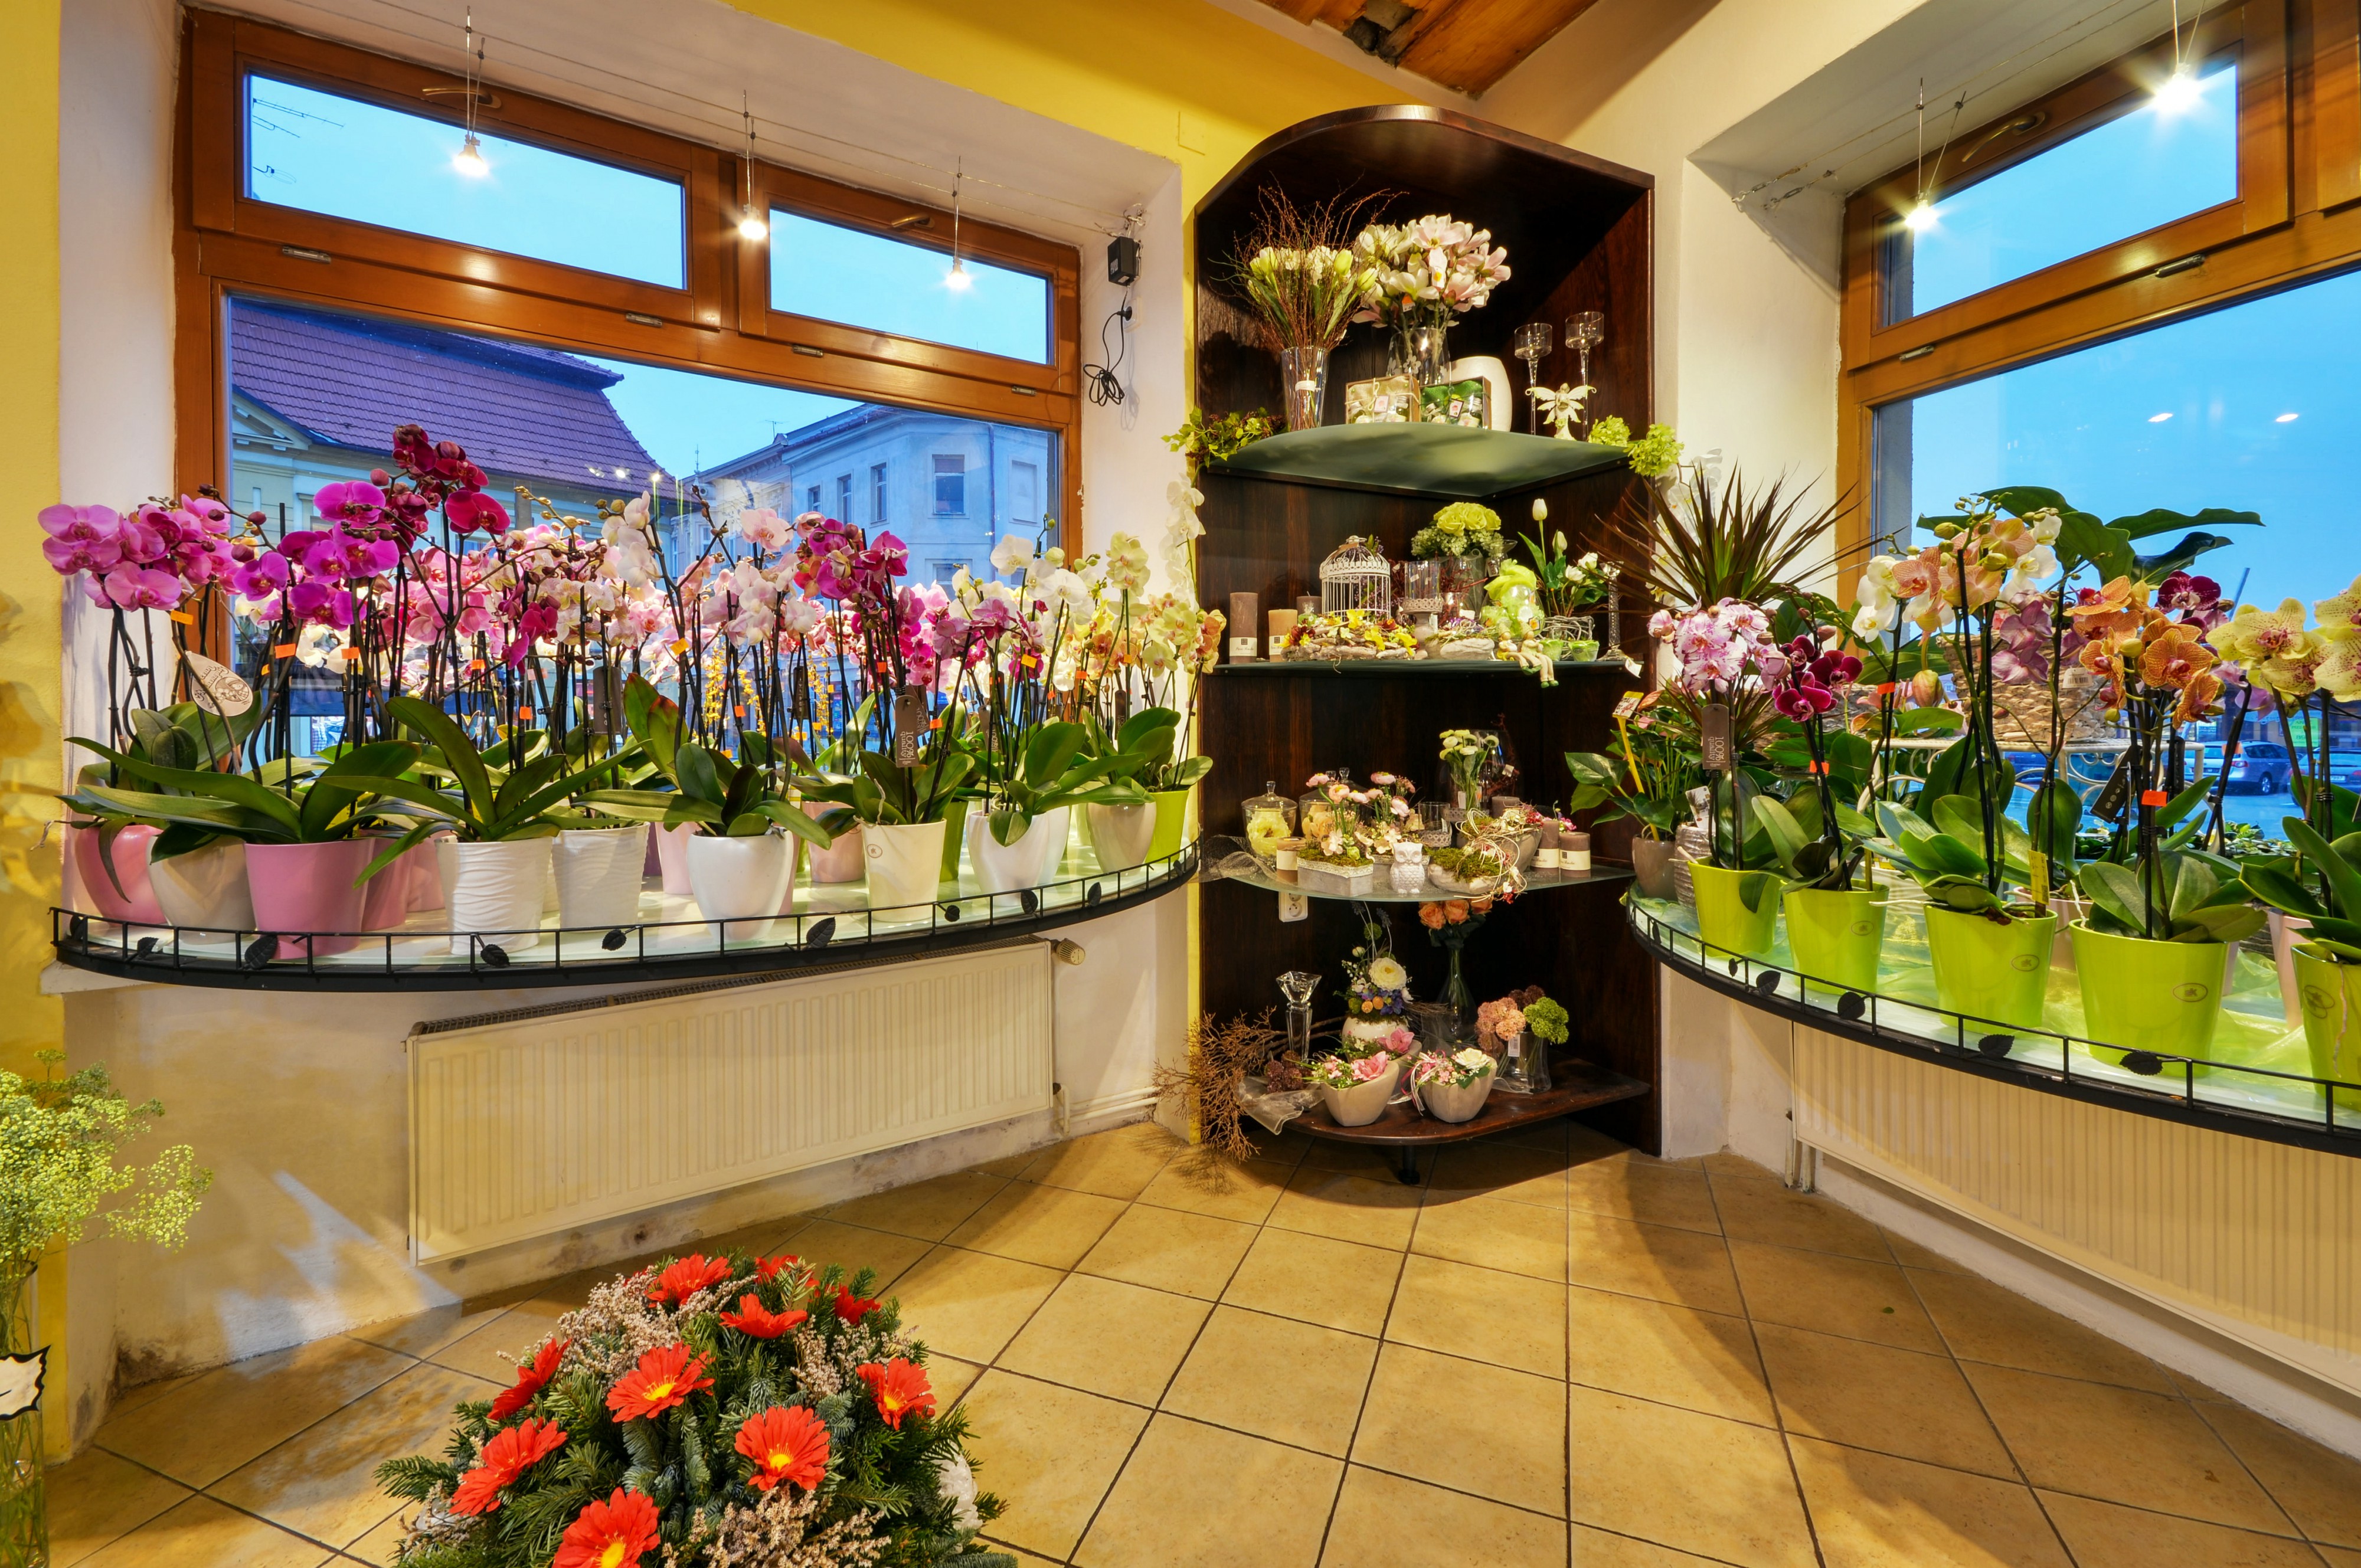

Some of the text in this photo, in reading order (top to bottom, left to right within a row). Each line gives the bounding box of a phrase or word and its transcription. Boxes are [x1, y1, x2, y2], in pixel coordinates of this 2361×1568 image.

[906, 731, 914, 758] 100%
[1708, 736, 1716, 760] quality
[1715, 736, 1724, 761] 100%
